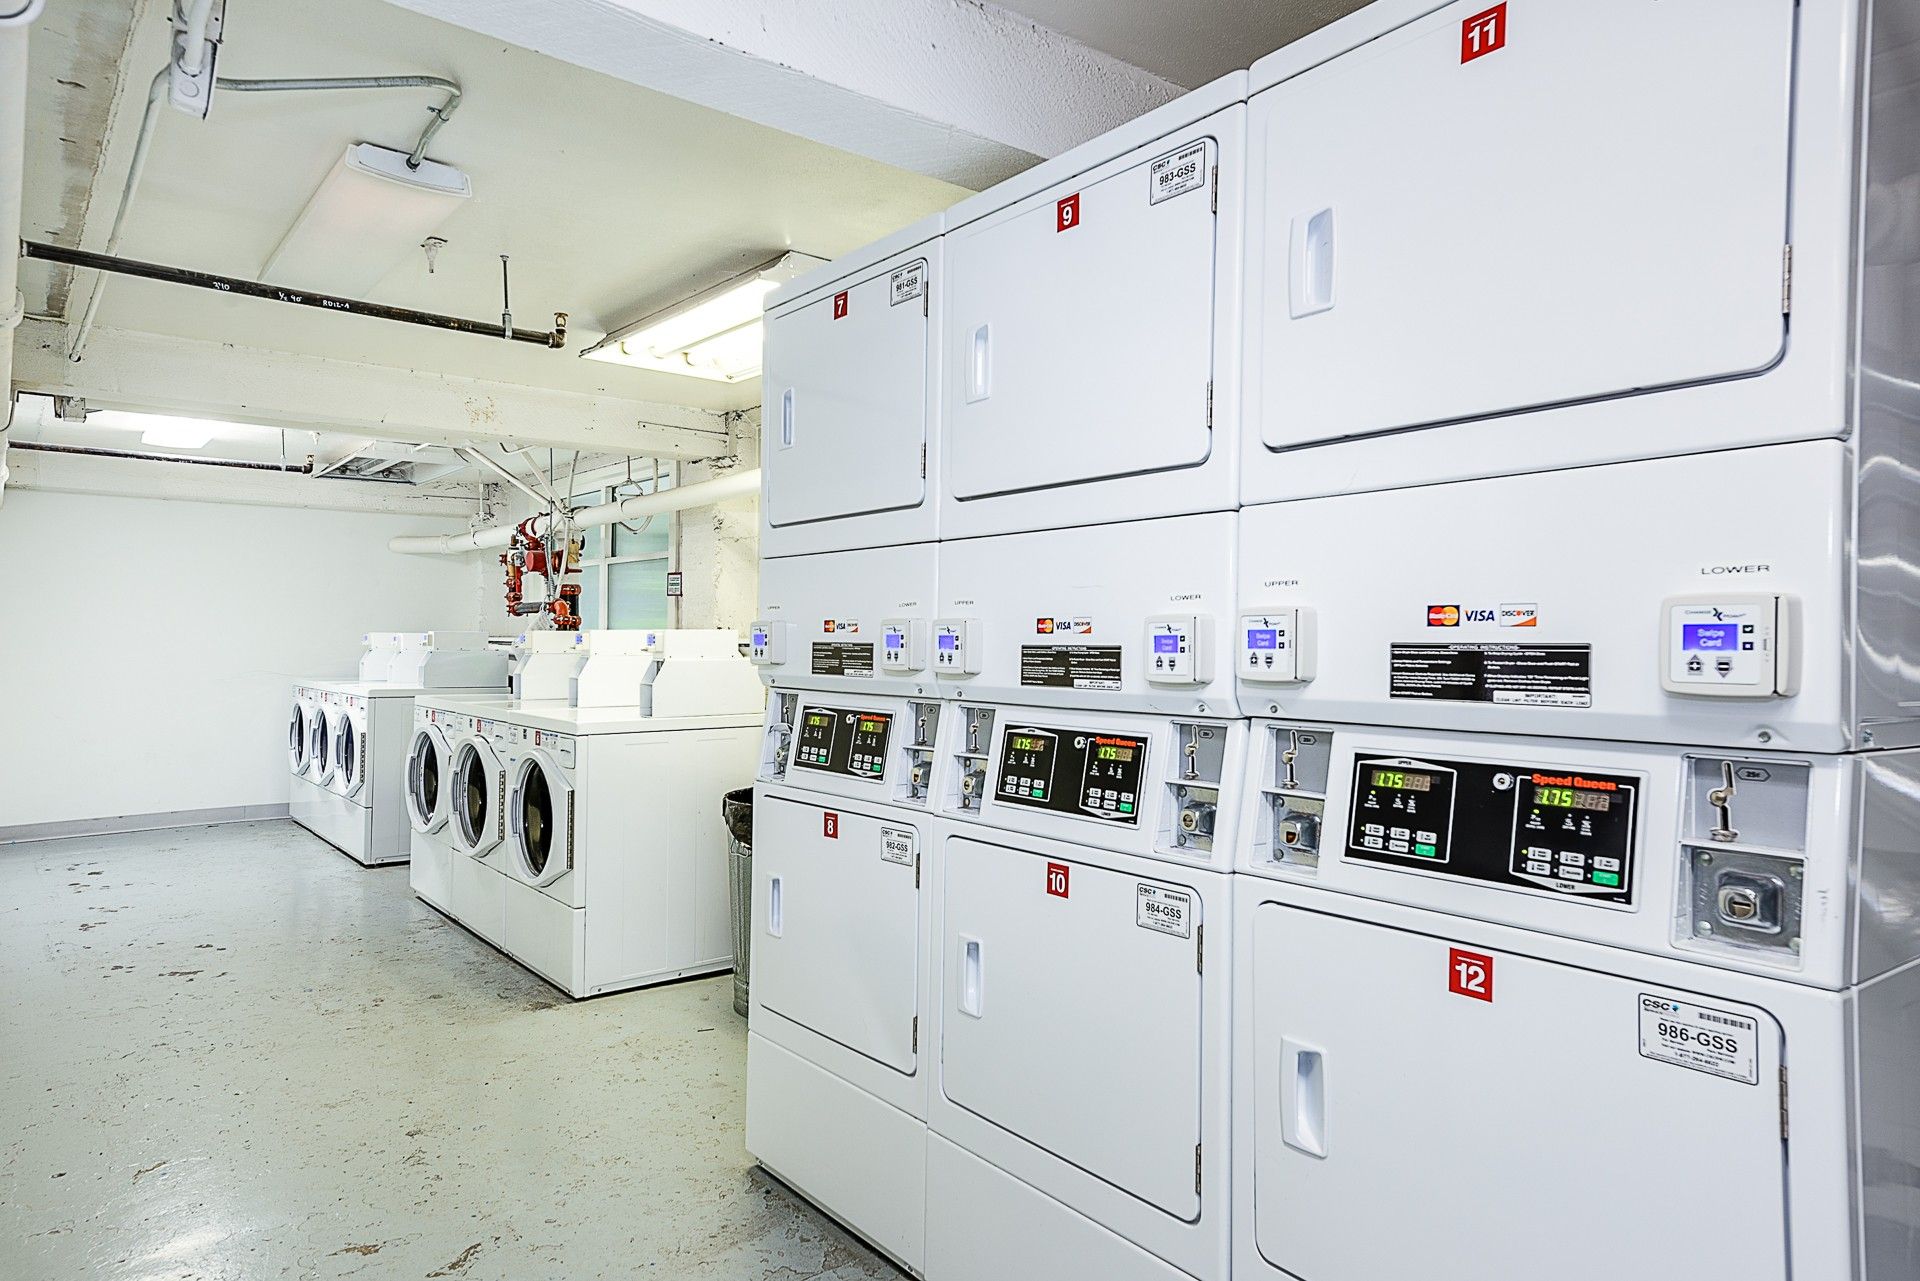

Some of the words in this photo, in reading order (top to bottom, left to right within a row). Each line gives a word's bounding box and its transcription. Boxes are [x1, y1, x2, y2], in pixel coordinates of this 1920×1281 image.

[1467, 18, 1496, 53] 11
[1159, 162, 1196, 185] 983-GSS
[1062, 205, 1073, 226] 9
[836, 299, 844, 316] 7
[1701, 564, 1770, 575] LOWER
[1264, 579, 1299, 587] UPPER
[1465, 610, 1495, 622] VISA
[1056, 621, 1072, 630] VISA
[1697, 628, 1725, 638] Swipe
[1699, 638, 1722, 647] Card
[1095, 736, 1115, 745] Speed
[1115, 738, 1137, 747] Queen
[1531, 773, 1573, 787] Speed
[1573, 776, 1617, 790] Queen
[827, 819, 834, 835] 8
[1049, 872, 1066, 894] 10
[1555, 882, 1575, 890] LOWER
[1145, 902, 1182, 919] 984-GSS
[1455, 962, 1486, 994] 12
[1642, 998, 1670, 1011] CSC
[1658, 1022, 1738, 1053] 986-GSS
